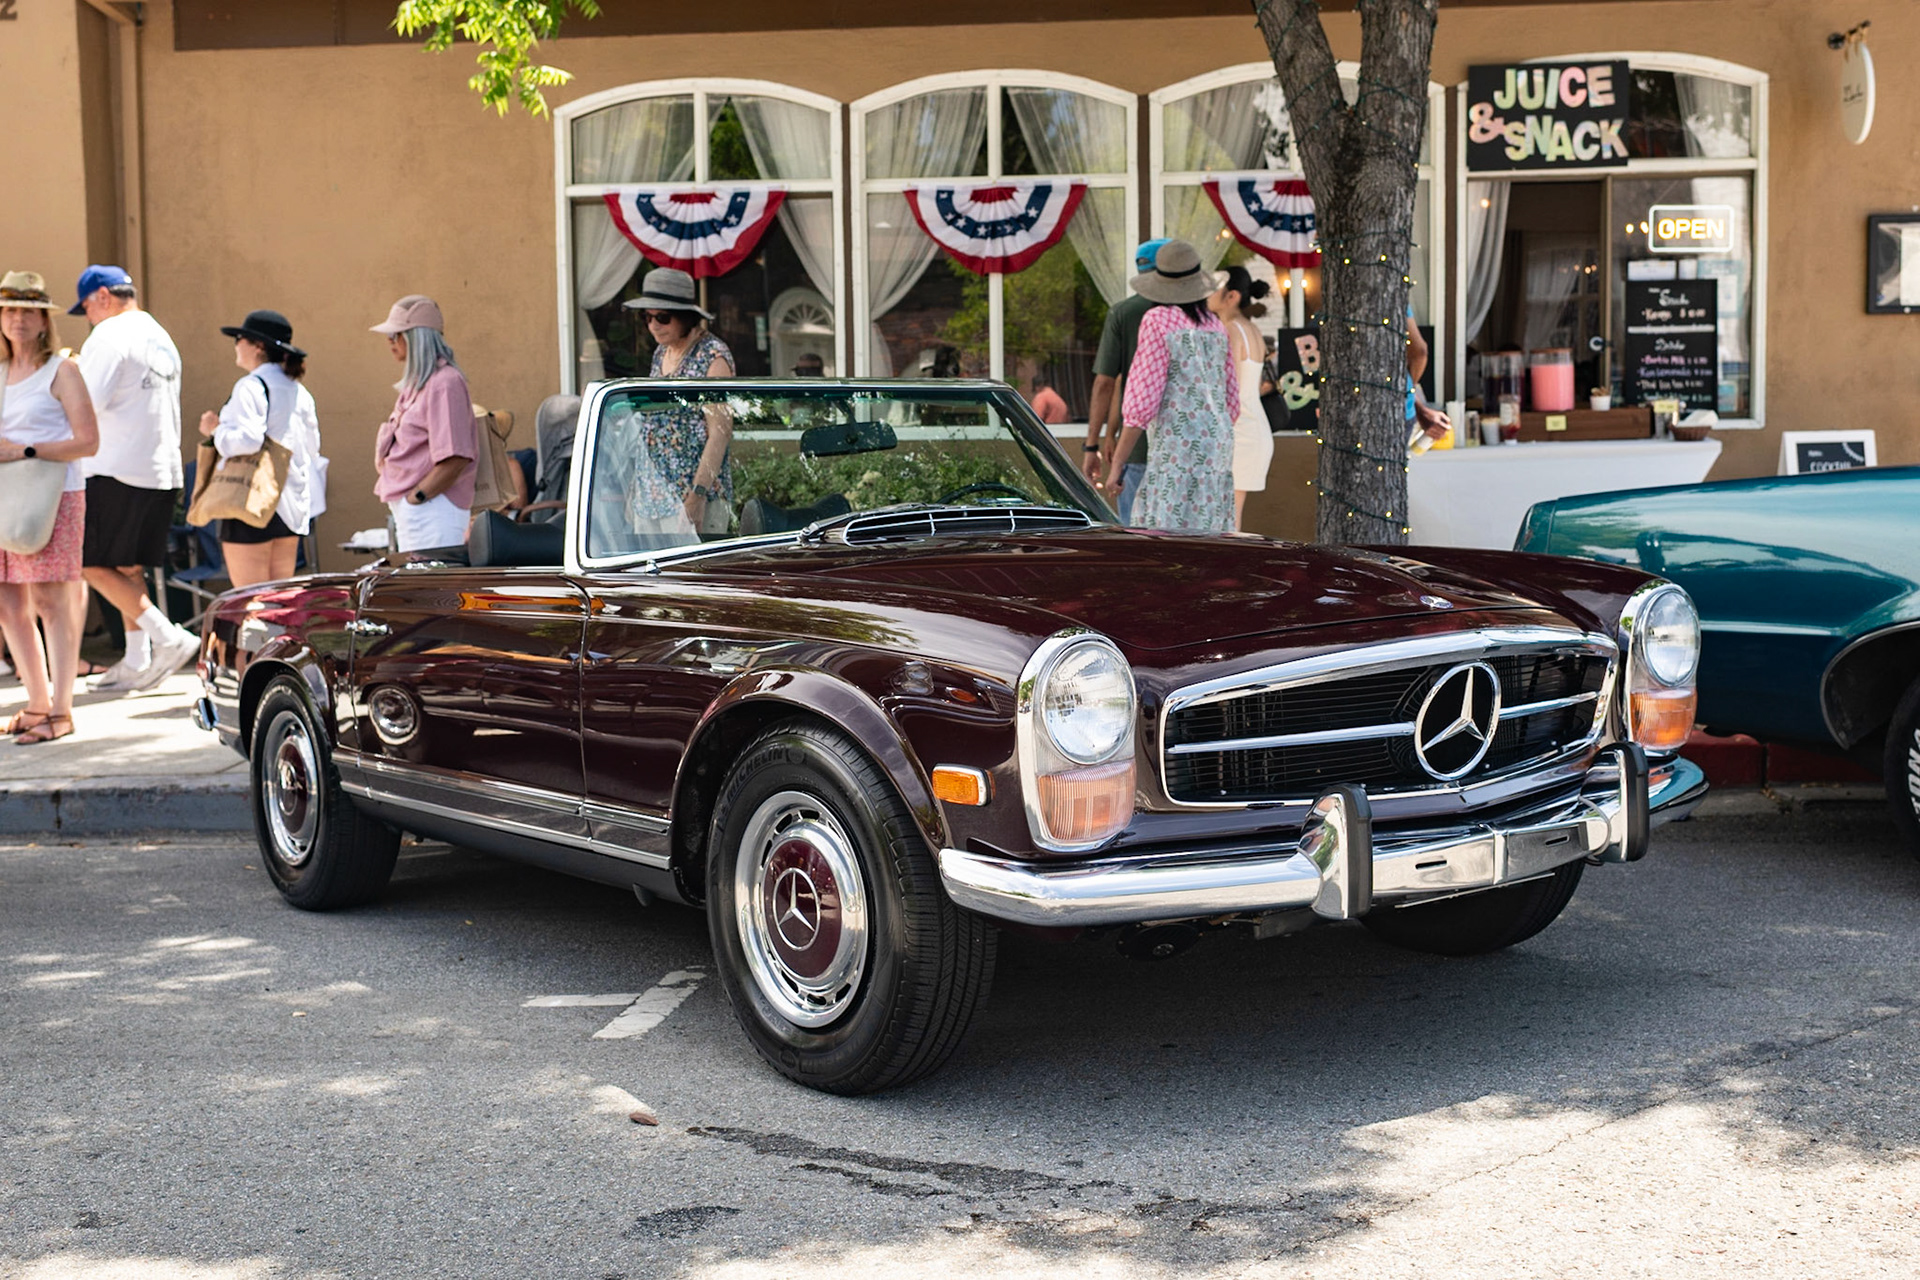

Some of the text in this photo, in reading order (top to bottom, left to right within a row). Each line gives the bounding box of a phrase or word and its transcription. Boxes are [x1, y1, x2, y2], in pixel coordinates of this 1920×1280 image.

[1493, 66, 1616, 110] JUICE
[1503, 115, 1629, 162] SNACK
[1658, 218, 1724, 239] OPEN
